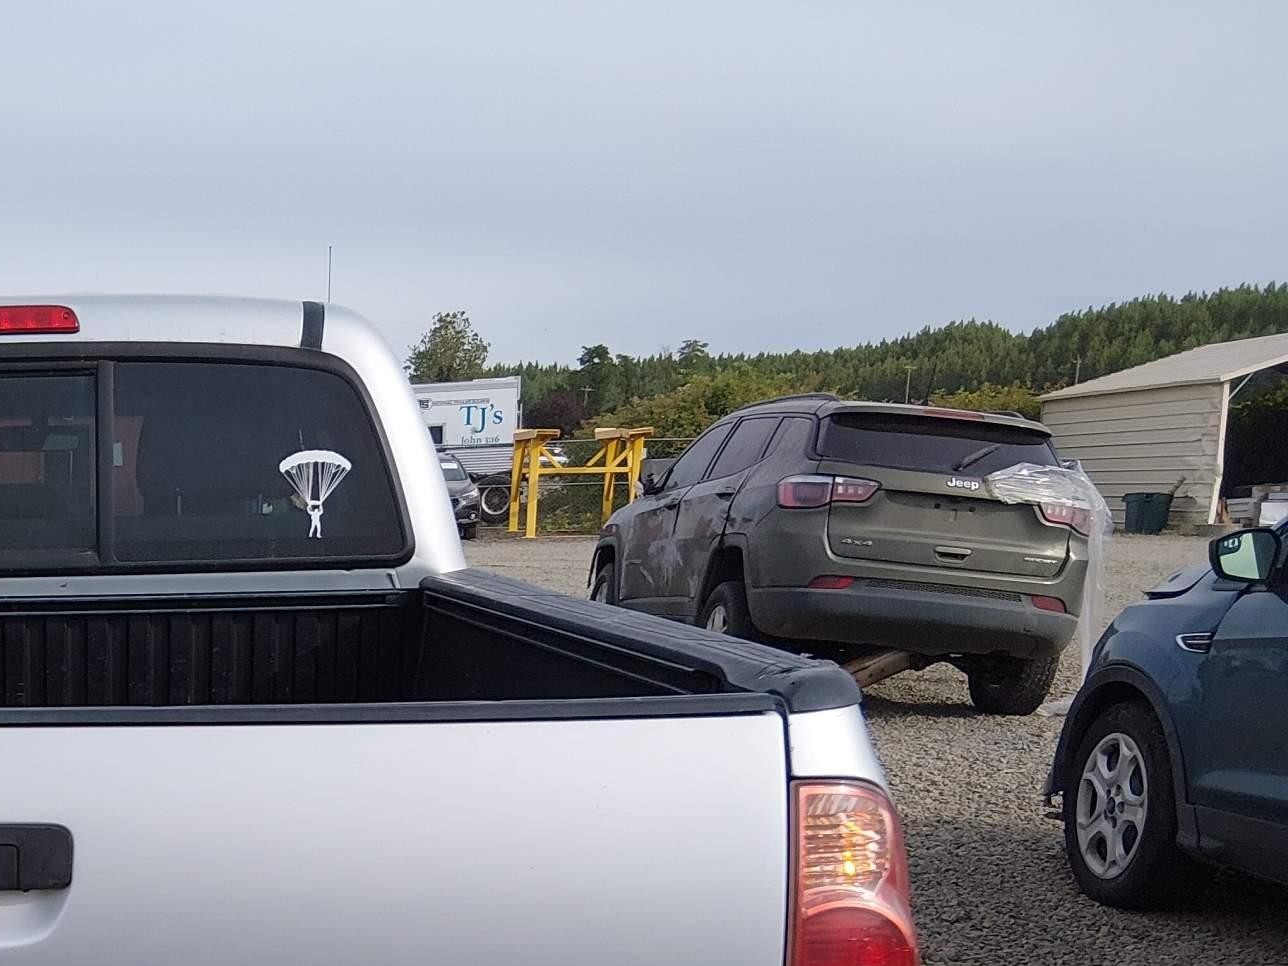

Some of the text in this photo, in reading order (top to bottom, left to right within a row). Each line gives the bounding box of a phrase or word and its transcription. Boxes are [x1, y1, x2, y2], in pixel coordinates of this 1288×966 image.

[459, 403, 503, 433] TJ's
[461, 435, 482, 446] John
[946, 477, 980, 491] Jeep
